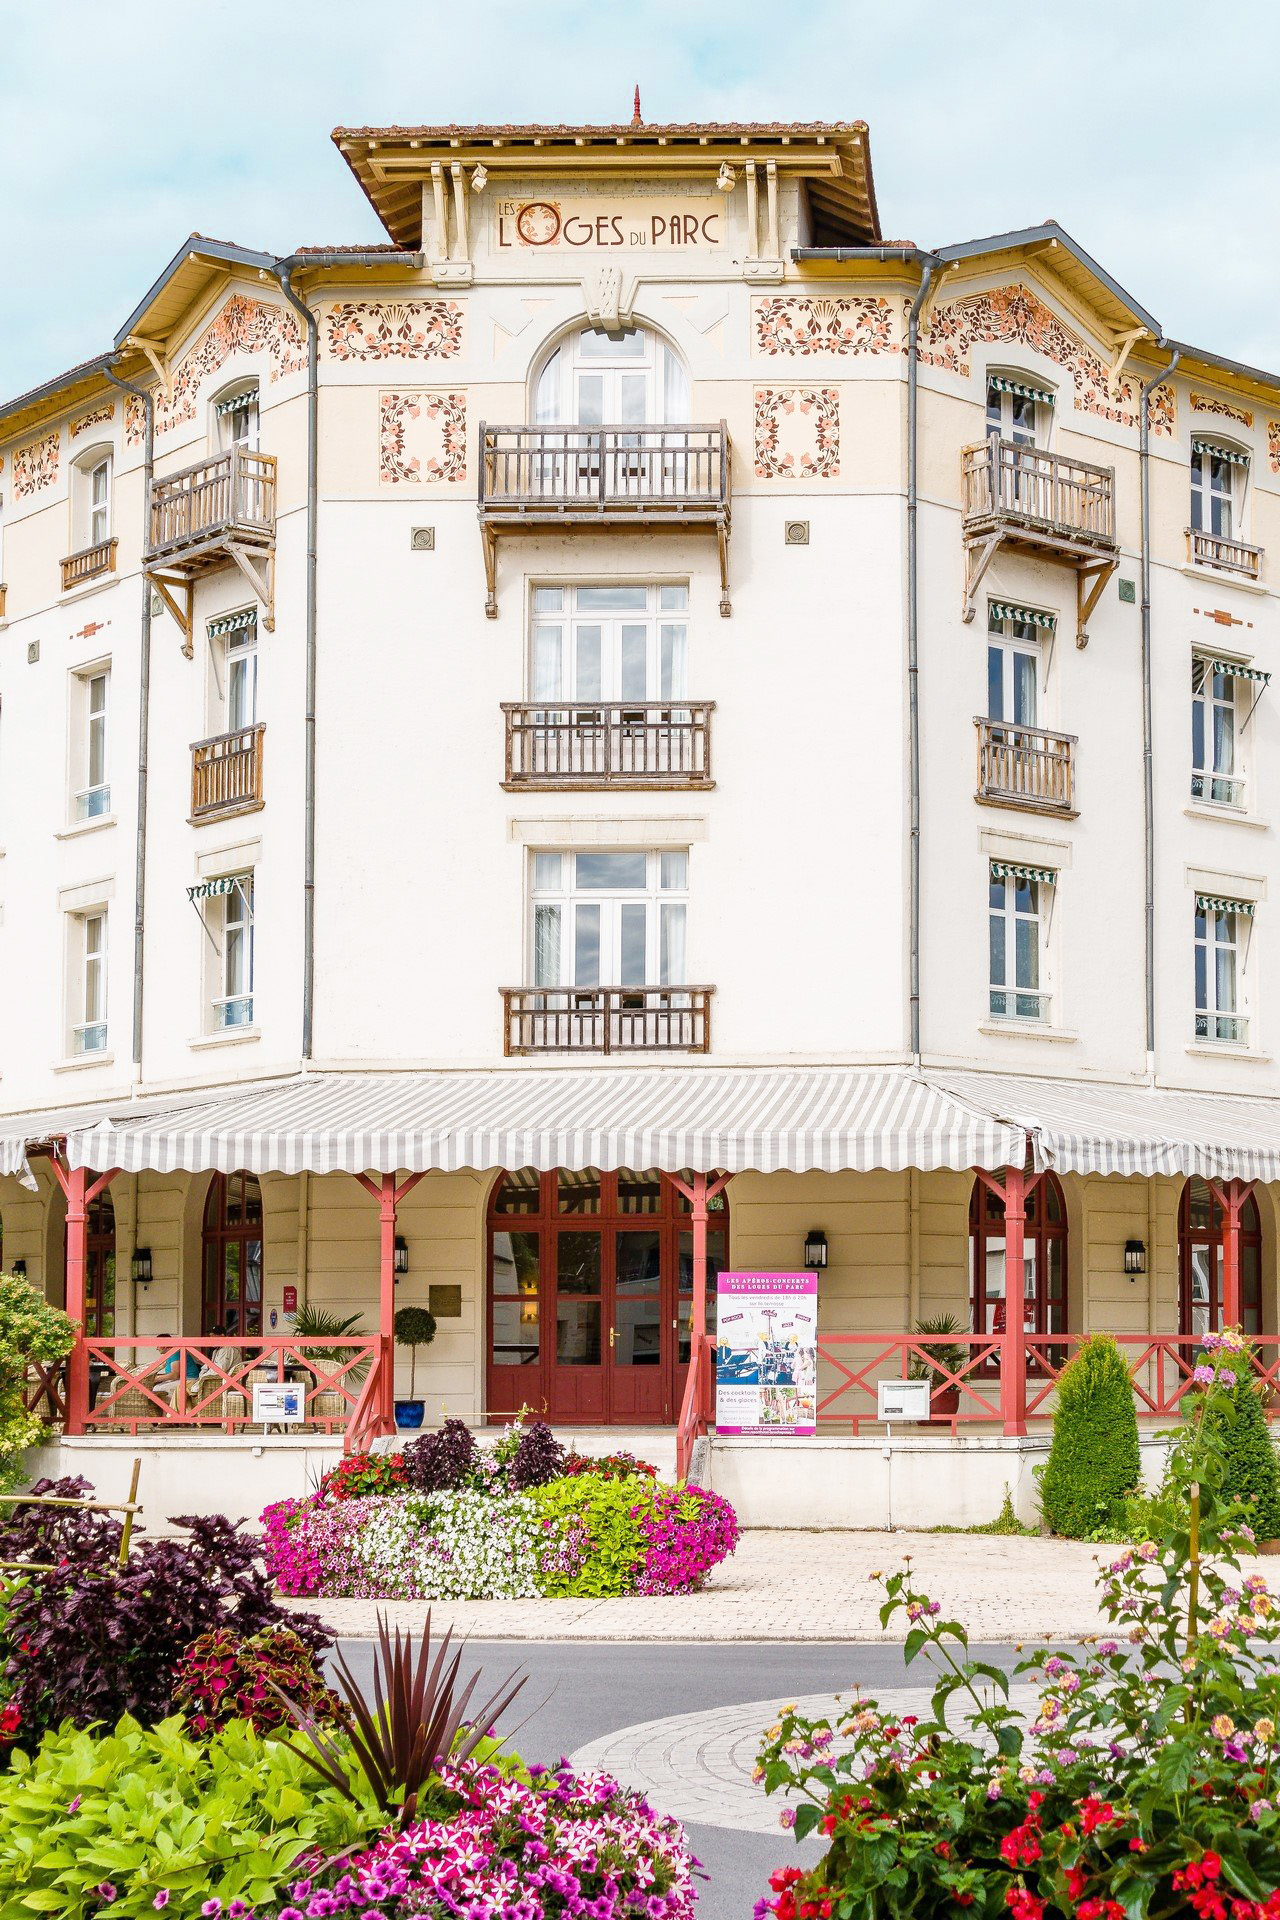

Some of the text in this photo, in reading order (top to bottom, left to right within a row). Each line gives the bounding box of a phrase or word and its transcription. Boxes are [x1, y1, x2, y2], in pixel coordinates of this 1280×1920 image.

[498, 203, 515, 216] LES
[499, 202, 719, 247] LOGES DU PARC
